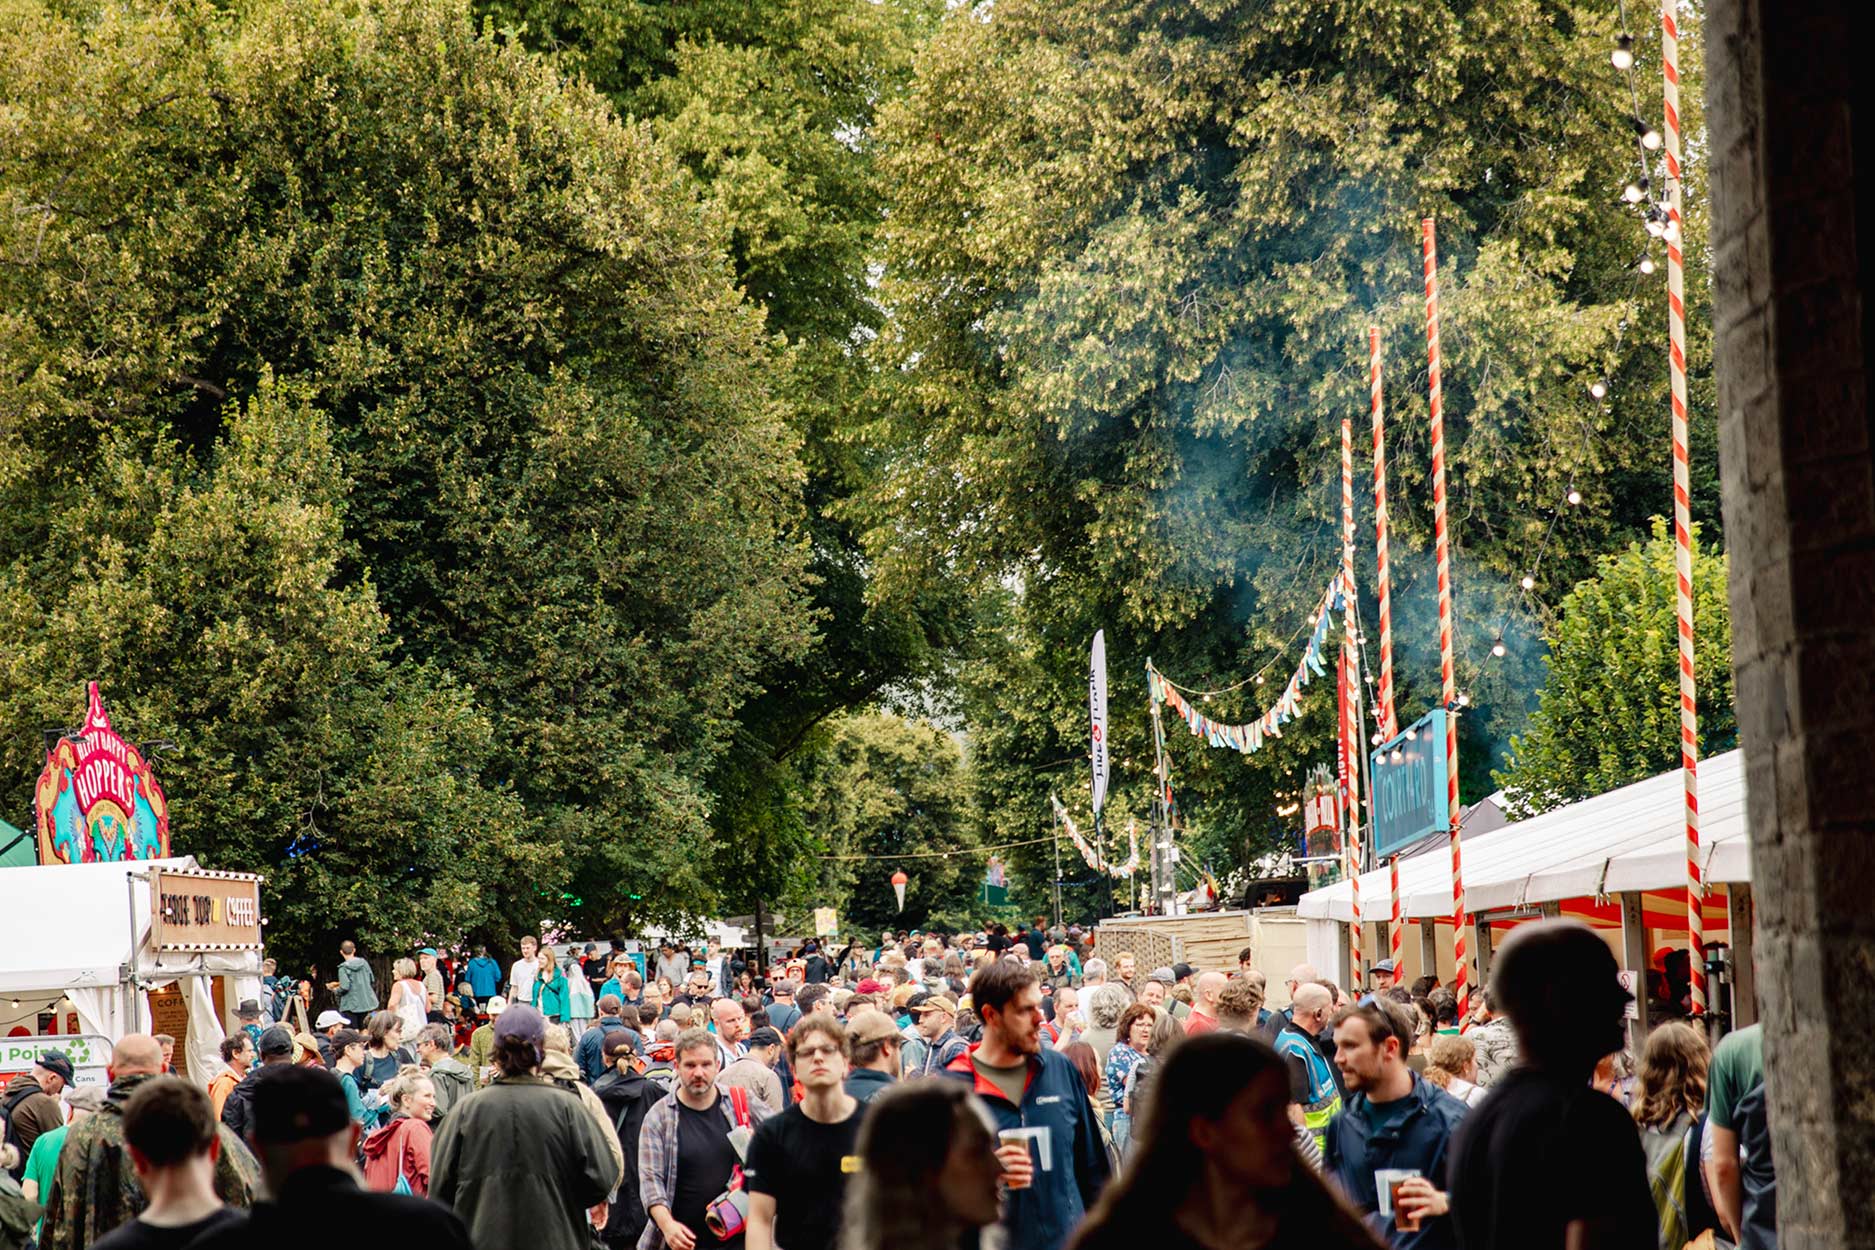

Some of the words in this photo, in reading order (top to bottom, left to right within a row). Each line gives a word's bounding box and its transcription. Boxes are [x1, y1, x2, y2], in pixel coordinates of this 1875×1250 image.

[77, 731, 99, 760] HIPPY
[100, 731, 125, 763] HAPPY
[77, 759, 132, 808] HOPPERS
[160, 893, 190, 926] TABLE
[192, 895, 210, 926] TOP
[225, 896, 254, 927] COFFEE
[9, 1045, 57, 1061] Poi
[75, 1075, 96, 1083] Cans
